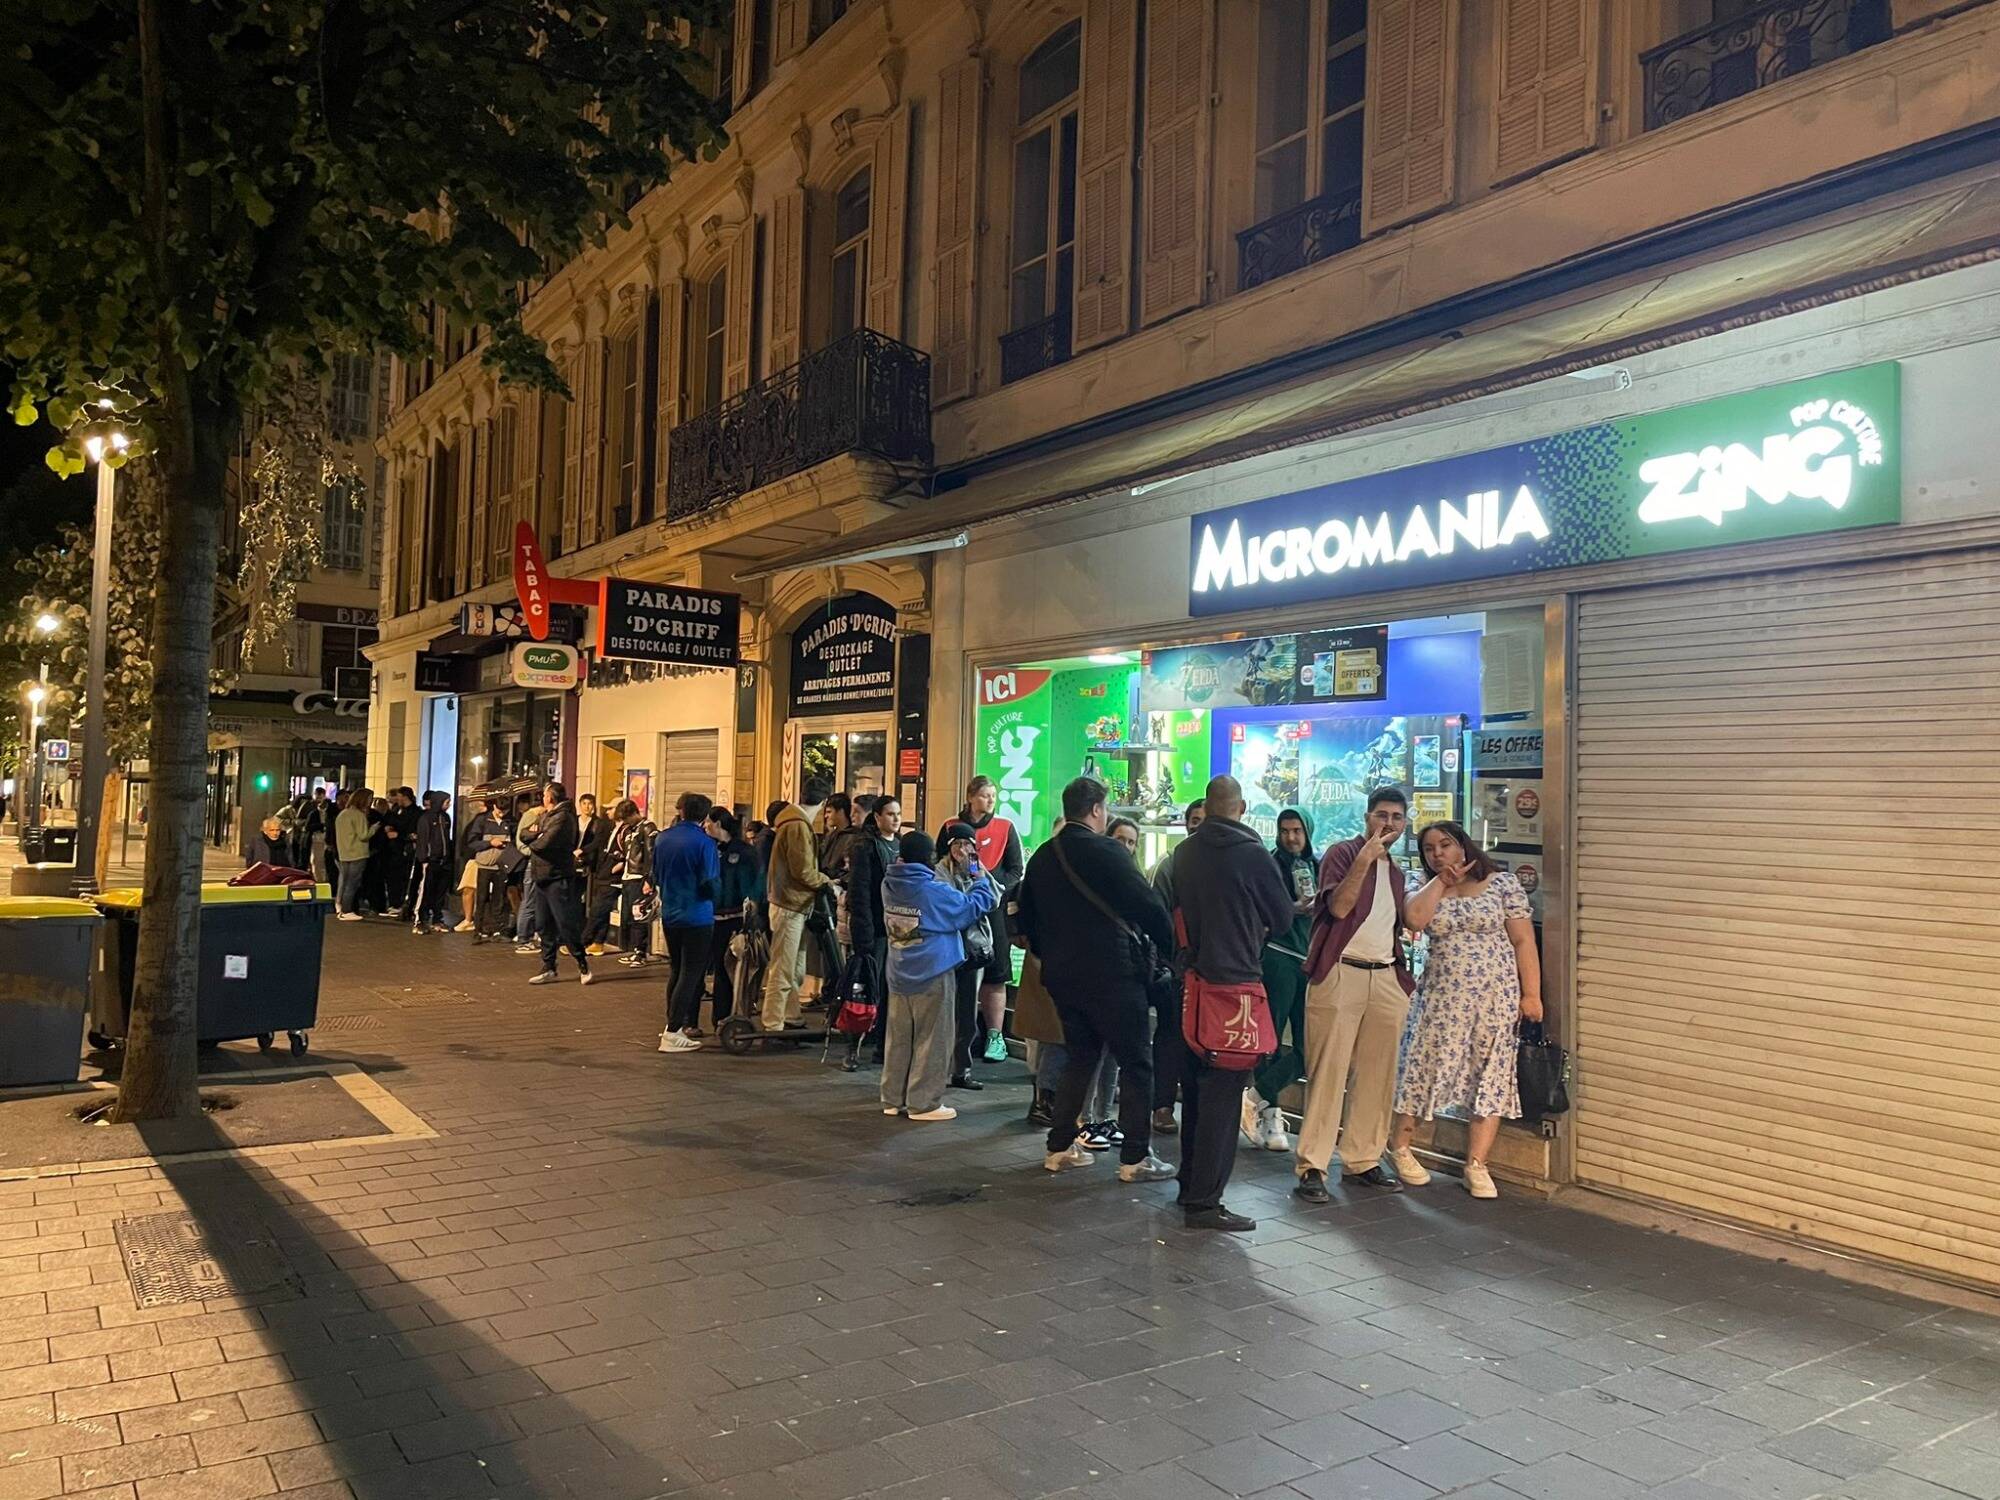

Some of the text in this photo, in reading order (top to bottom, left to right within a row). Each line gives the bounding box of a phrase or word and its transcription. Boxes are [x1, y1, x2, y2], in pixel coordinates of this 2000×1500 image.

[1790, 398, 1882, 467] POP CULTURE
[522, 545, 543, 616] TABAC
[626, 589, 722, 616] PARADIS
[801, 615, 848, 658] PARADIS
[611, 636, 681, 654] DESTOCKAGE
[692, 645, 732, 659] OUTLET
[819, 640, 874, 660] DESTOCKAGE
[528, 655, 551, 664] PMU
[829, 656, 862, 673] OUTLET
[518, 672, 573, 684] express
[803, 671, 891, 691] ARRIVAGES PERMANENTS
[985, 672, 1016, 703] ICI
[988, 711, 1024, 754] POP CULTURE
[1480, 737, 1502, 754] LES
[1224, 1030, 1260, 1050] アタリ
